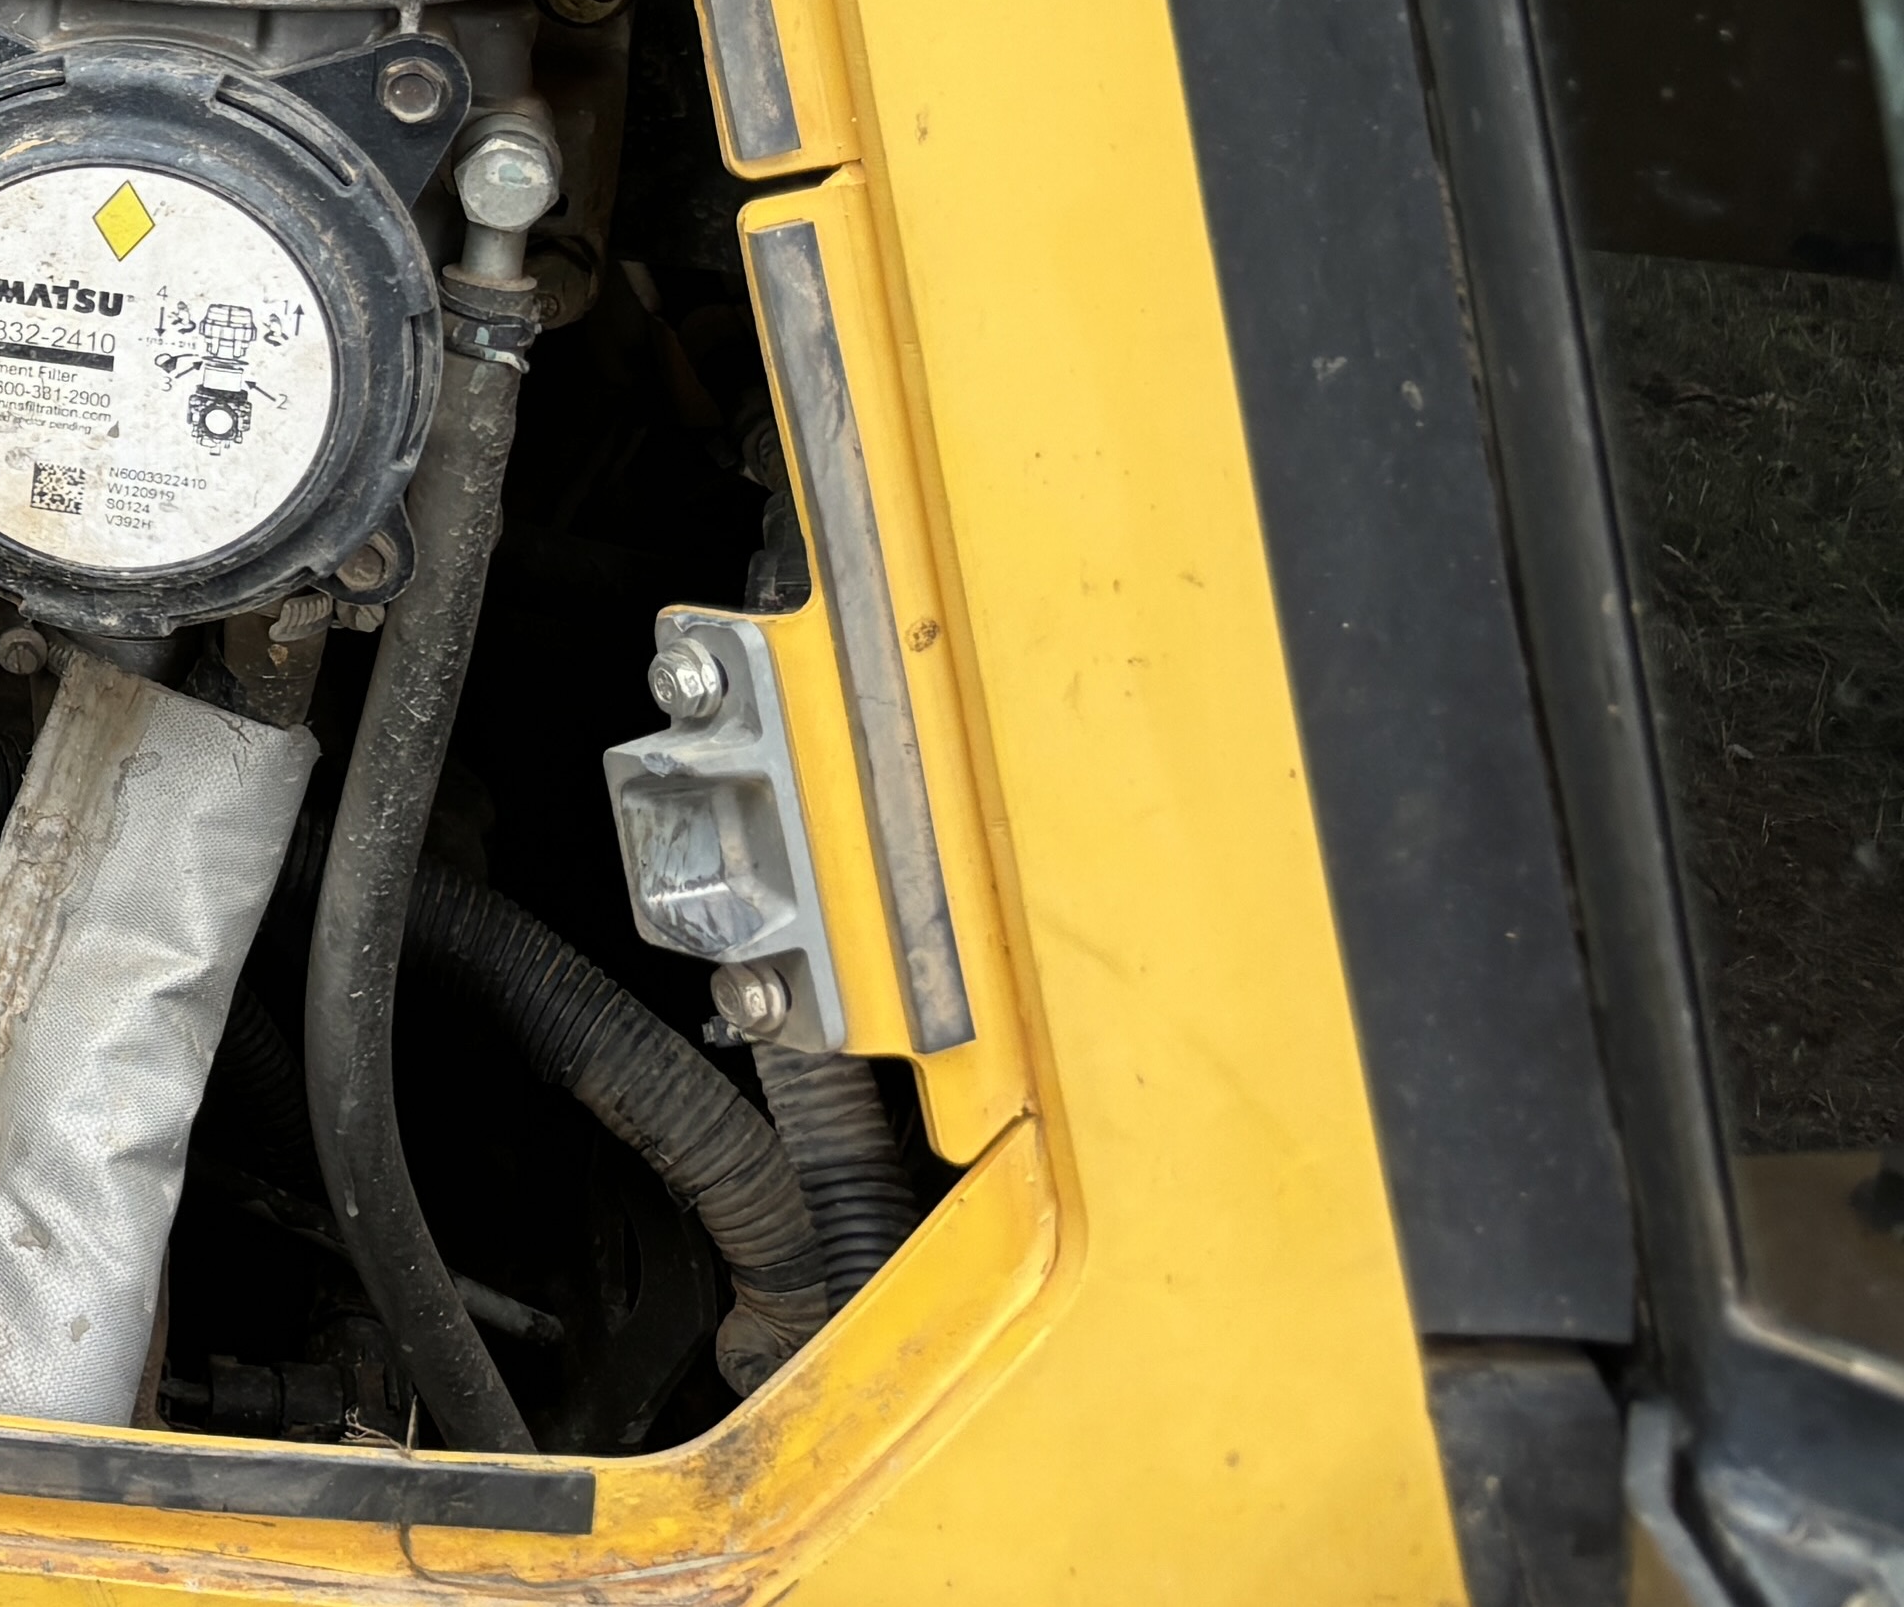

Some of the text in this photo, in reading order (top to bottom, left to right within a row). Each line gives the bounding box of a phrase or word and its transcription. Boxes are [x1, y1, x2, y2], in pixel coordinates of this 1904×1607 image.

[156, 285, 168, 301] 4
[161, 377, 173, 392] 3
[276, 393, 288, 410] 2
[108, 467, 207, 490] N6003322410
[107, 482, 175, 502] W120919
[105, 498, 151, 514] S0124
[104, 513, 153, 530] V392H
